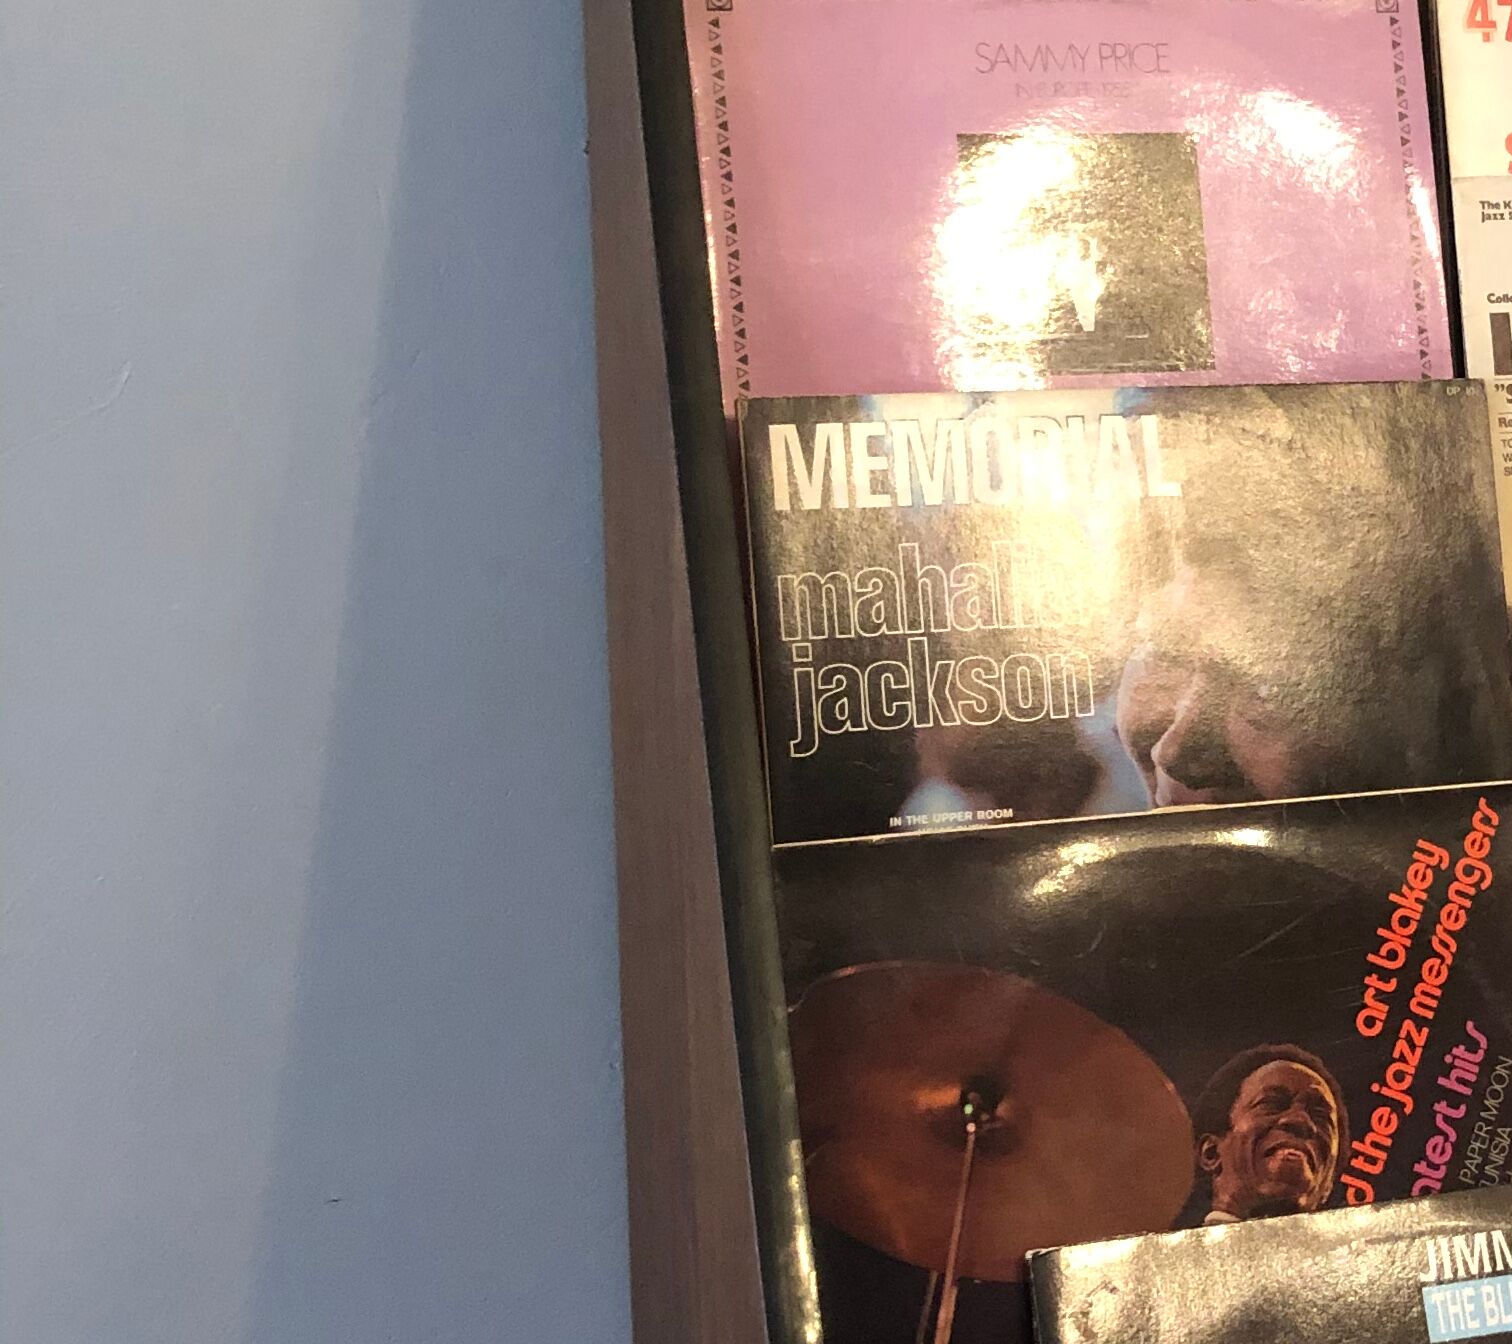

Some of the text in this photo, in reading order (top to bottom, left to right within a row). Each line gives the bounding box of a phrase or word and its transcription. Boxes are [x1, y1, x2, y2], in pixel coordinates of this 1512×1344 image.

[975, 42, 1171, 75] SAMMY PRICE
[1479, 200, 1501, 210] The
[1481, 211, 1505, 223] Jazz
[768, 414, 1182, 511] MEMORIAL
[790, 637, 1095, 758] jackson
[889, 808, 1014, 827] IN THE UPPER ROOM
[1355, 838, 1450, 1037] art blakey
[1409, 796, 1500, 1020] messengers
[1370, 1018, 1430, 1116] jazz
[1437, 1020, 1488, 1096] hits
[1350, 1106, 1399, 1175] the
[1458, 1121, 1493, 1185] PAPER
[1431, 1289, 1481, 1334] THE
